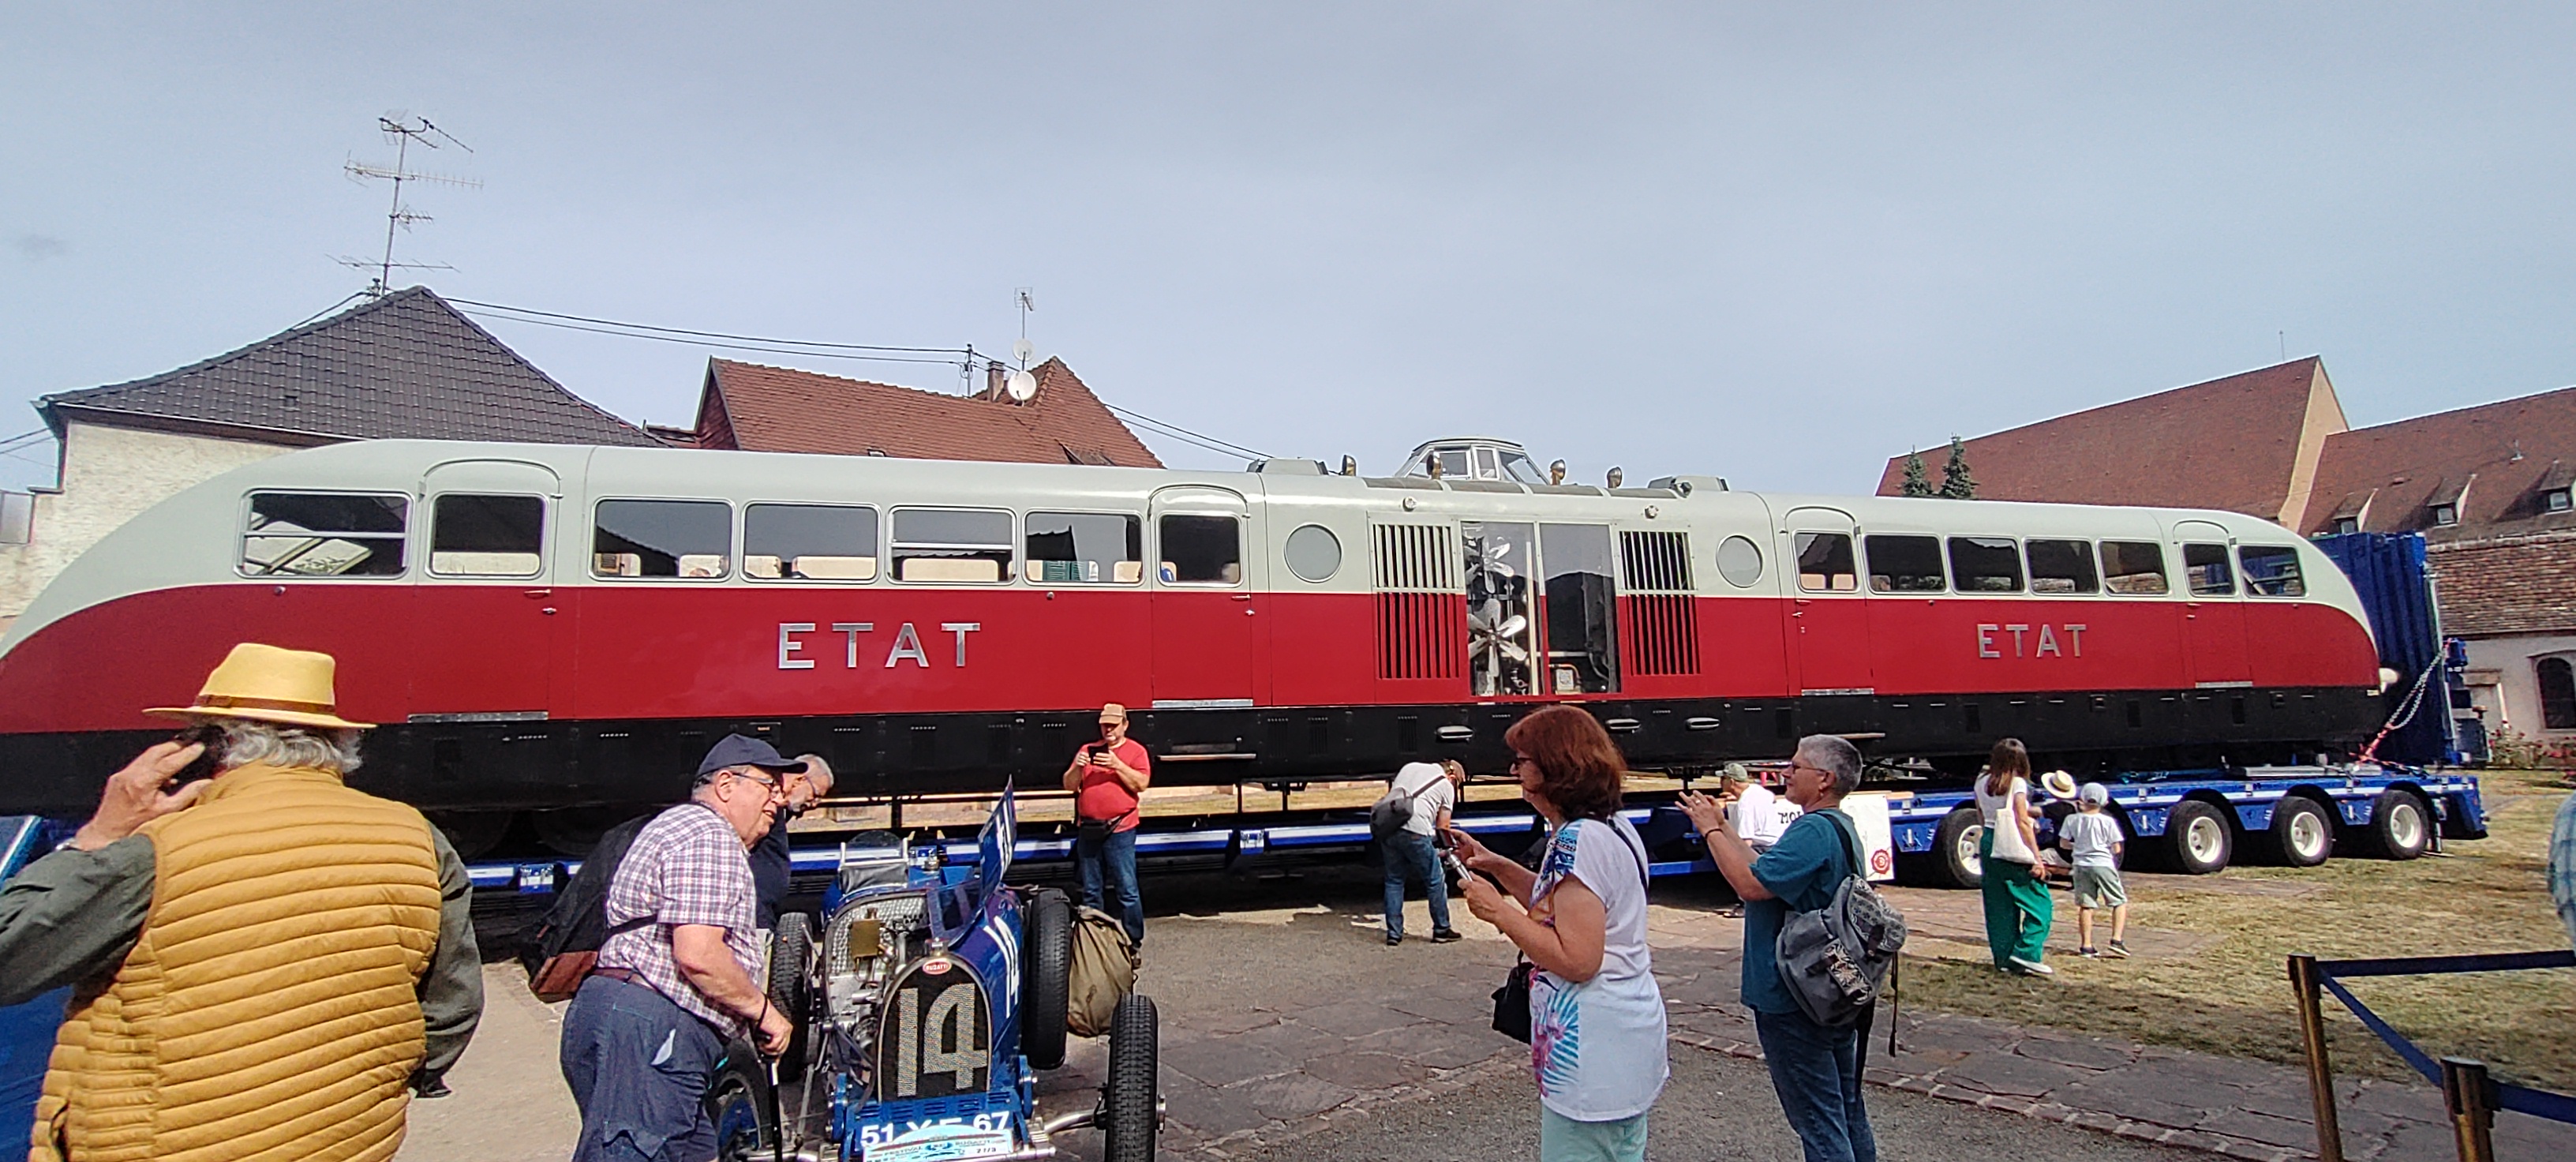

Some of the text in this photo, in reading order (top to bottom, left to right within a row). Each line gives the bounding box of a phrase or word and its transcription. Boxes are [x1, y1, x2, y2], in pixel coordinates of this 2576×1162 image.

[777, 622, 981, 669] ETAT
[1976, 624, 2087, 658] ETAT
[897, 983, 987, 1097] 14
[860, 1123, 893, 1147] 51
[973, 1110, 1009, 1132] 67
